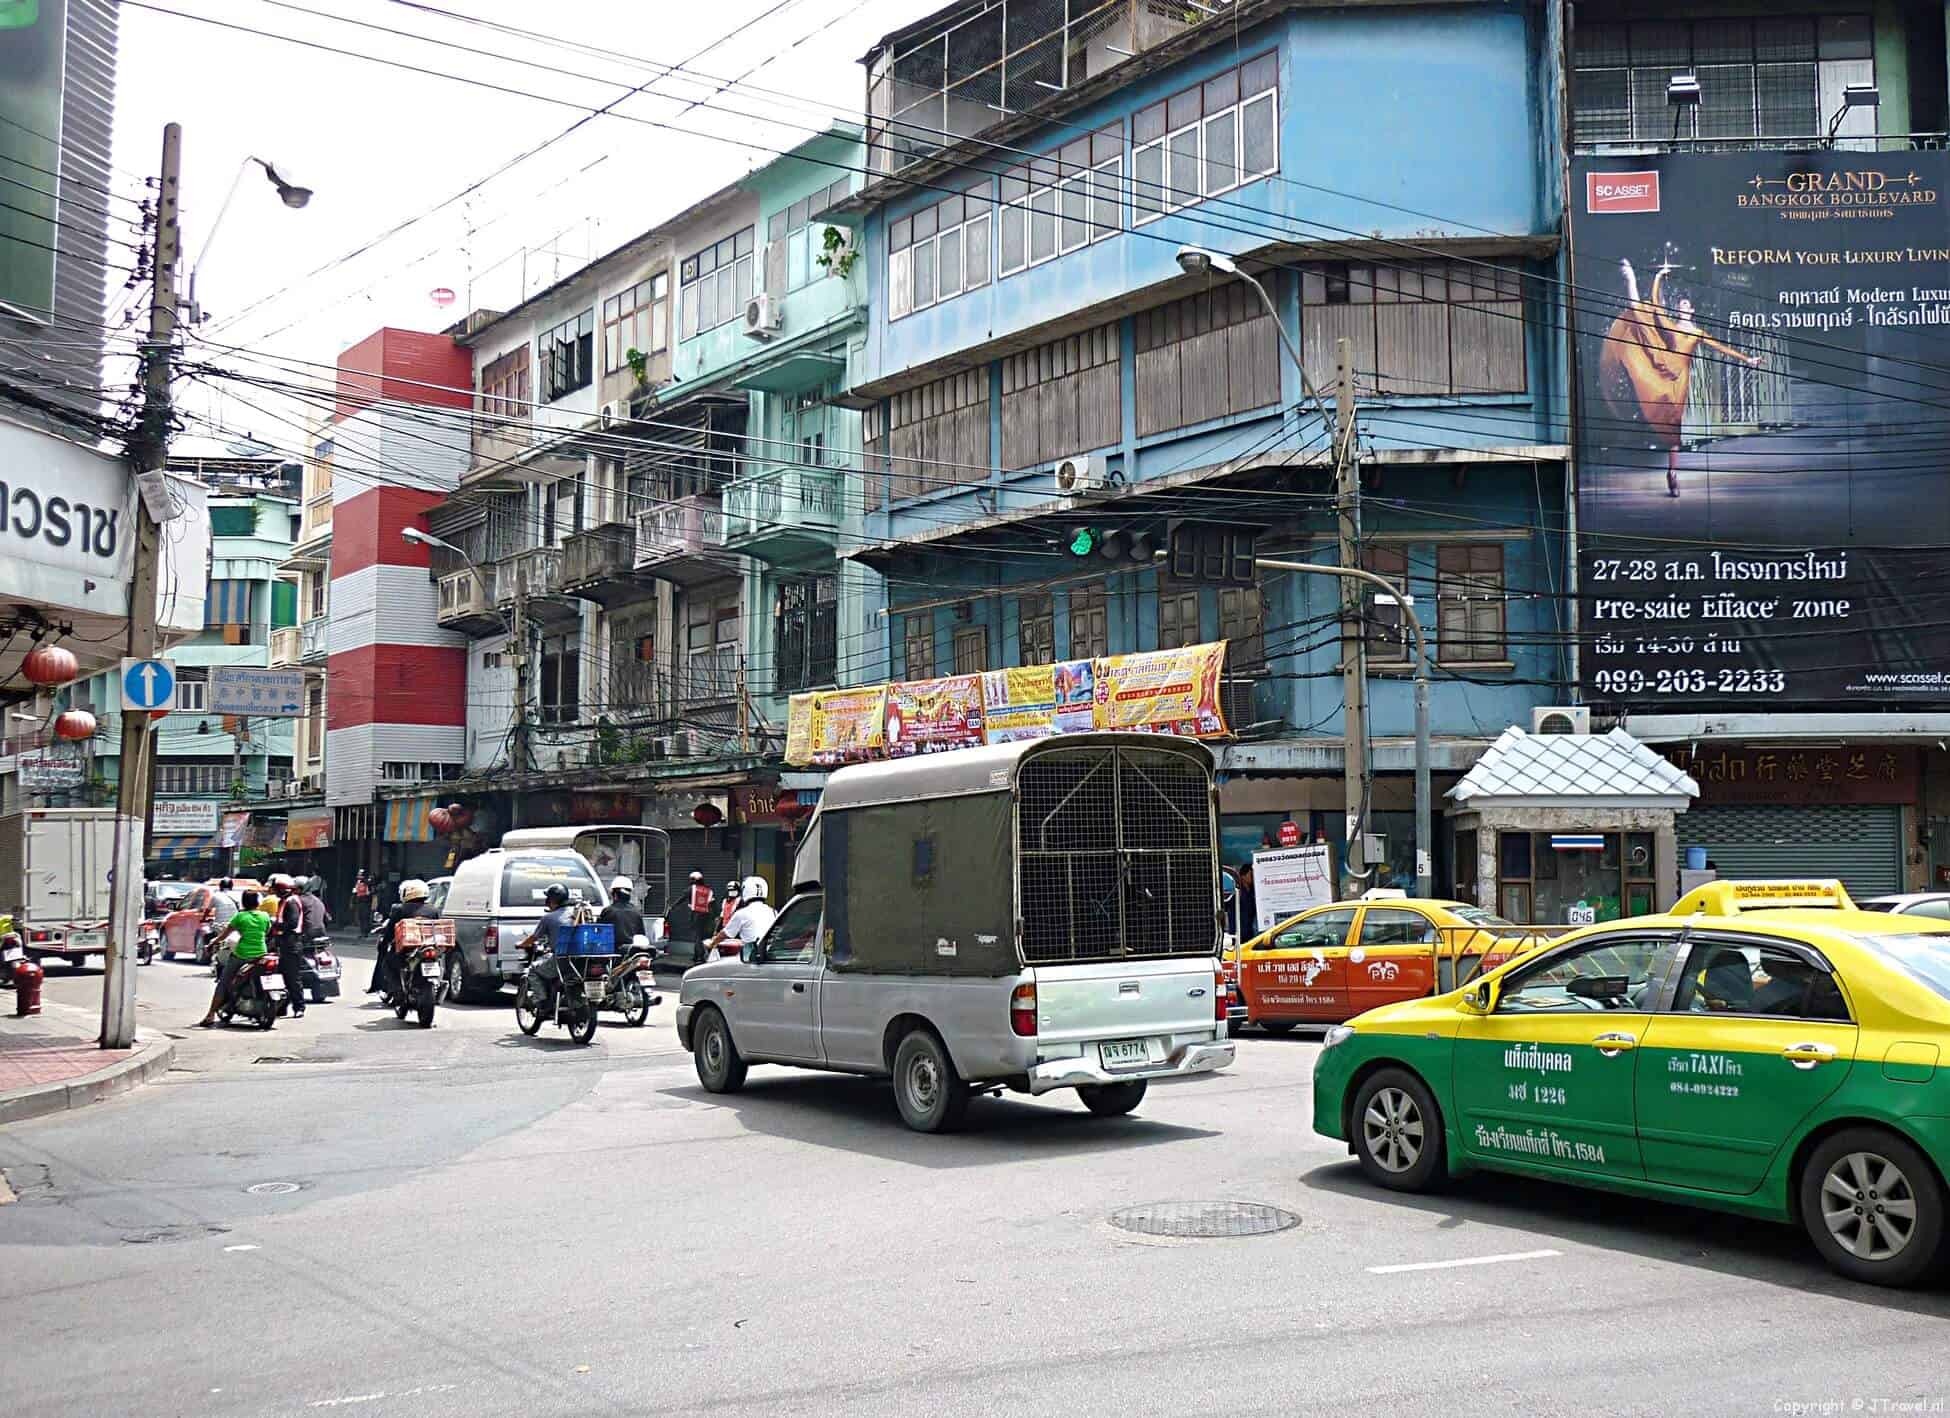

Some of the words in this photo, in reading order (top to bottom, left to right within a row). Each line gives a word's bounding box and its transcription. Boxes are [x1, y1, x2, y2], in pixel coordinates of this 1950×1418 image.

[1787, 171, 1885, 191] GRAND
[1595, 184, 1612, 196] SC
[1614, 184, 1649, 195] ASSET
[1737, 194, 1824, 207] BANGKOK
[1830, 190, 1936, 205] BOULEVARD
[1712, 248, 1791, 265] REFORM
[1796, 251, 1840, 265] YOUR
[1845, 250, 1903, 264] LUXURY
[1847, 287, 1905, 304] Modern
[1593, 560, 1657, 581] 27-28
[1665, 561, 1705, 580] ส.ค.
[1711, 551, 1847, 580] โครงการใหม่
[1593, 594, 1690, 619] Pre-sale
[1792, 600, 1850, 618] zone
[1595, 669, 1785, 693] 089-203-2233
[1418, 863, 1424, 874] 5
[1372, 969, 1395, 979] PYS
[1121, 1039, 1146, 1056] 6774
[1504, 1042, 1572, 1076] แท็กซี่บุคคล
[1690, 1054, 1724, 1075] TAXI
[1534, 1086, 1566, 1104] 1226
